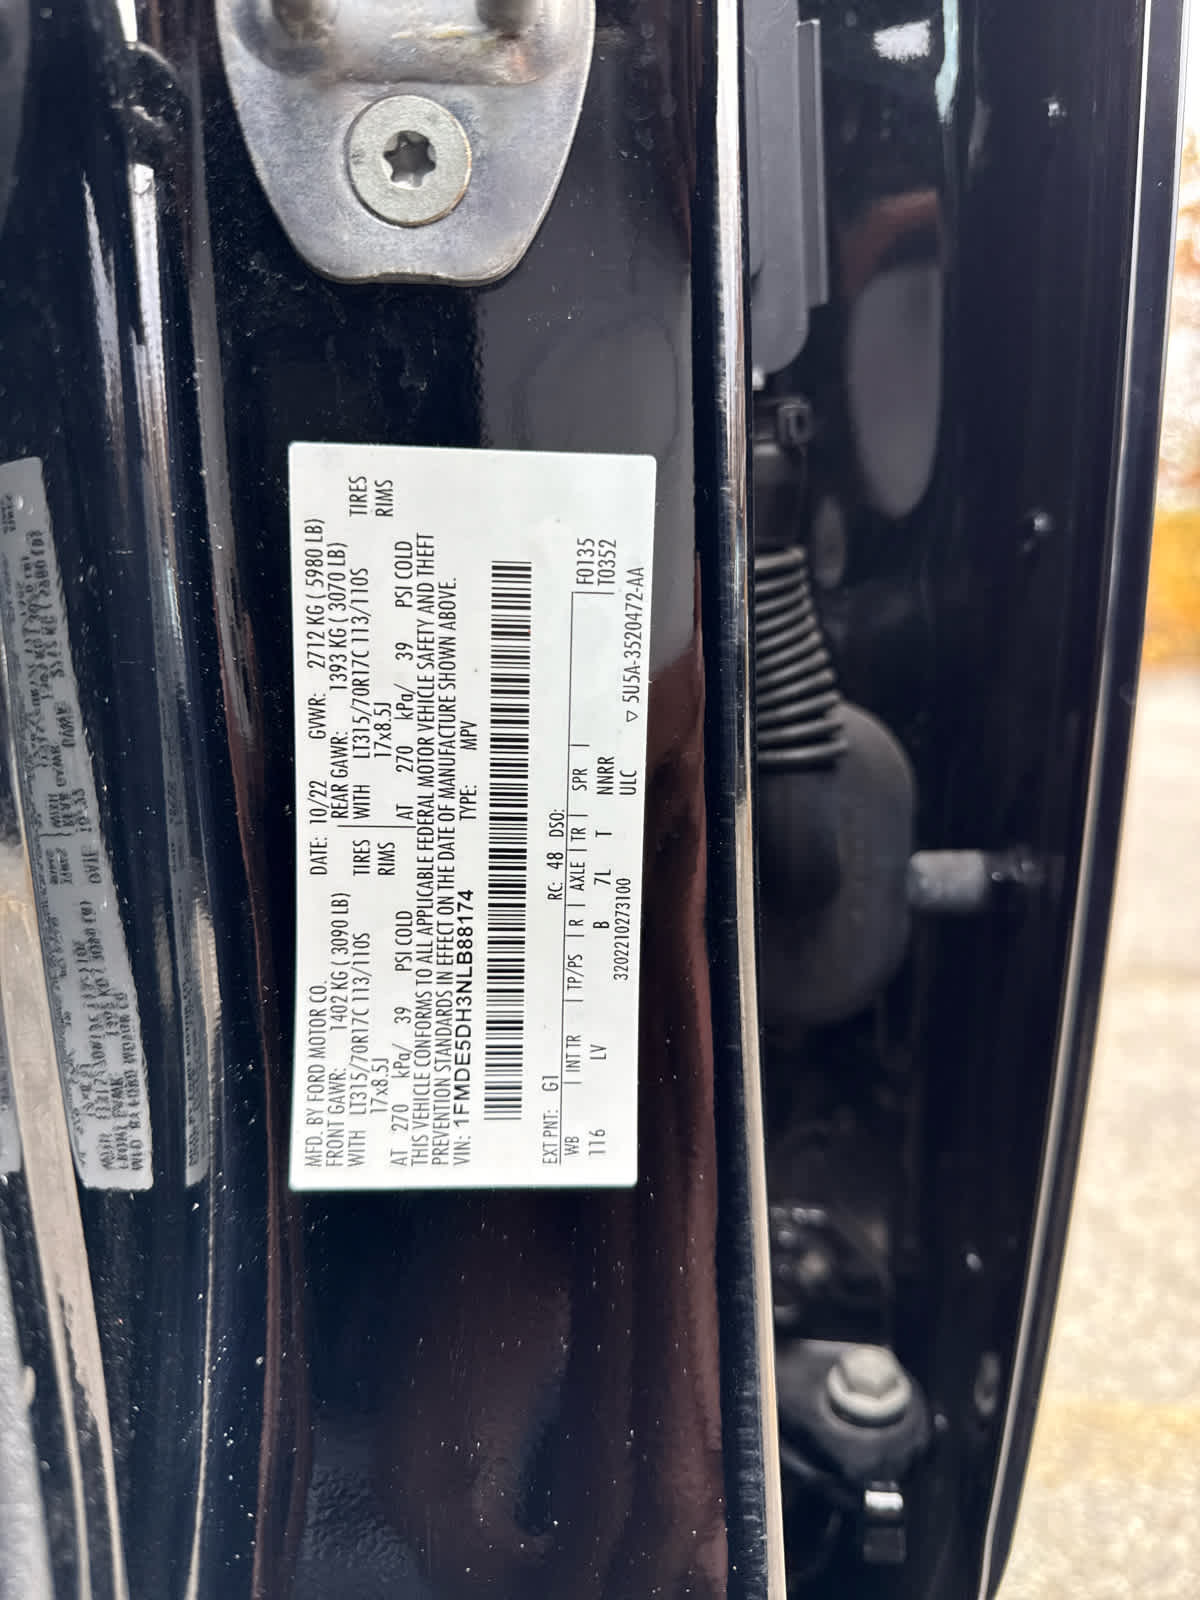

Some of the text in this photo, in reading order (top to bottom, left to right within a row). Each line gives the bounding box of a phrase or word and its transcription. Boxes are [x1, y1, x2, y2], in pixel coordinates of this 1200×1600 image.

[347, 475, 368, 518] TIRES
[374, 479, 394, 518] RIMS
[303, 518, 325, 543] LB)
[304, 548, 325, 589] 5980
[327, 542, 348, 567] LB)
[576, 537, 596, 585] F0135
[597, 539, 617, 587] T0352
[327, 571, 347, 612] 3070
[305, 604, 326, 626] KG
[306, 630, 326, 669] 2712
[327, 627, 348, 649] KG
[329, 653, 349, 691] 1393
[393, 540, 416, 821] AT 270 kPa/ 39 PSI COLD
[349, 567, 371, 820] WITH LT315/70R17C 113/110S
[307, 692, 328, 740] GVWR:
[374, 701, 393, 758] 17x8.5J
[329, 731, 349, 779] GAWR:
[459, 720, 478, 821] TYPE: MPV
[571, 768, 588, 792] SPR
[596, 756, 614, 796] NNRR
[619, 769, 638, 796] ULC
[330, 783, 349, 819] REAR
[307, 780, 329, 876] DATE: 10/22
[548, 808, 565, 838] DSO:
[570, 827, 587, 843] TR
[595, 829, 613, 838] T
[351, 839, 371, 877] TIRES
[377, 841, 396, 876] RIMS
[411, 532, 435, 1167] THIS VEHICLE CONFORMS TO ALL APPLICABLE FEDERAL MOTOR VEHICLE SAFETY AND THEFT
[431, 577, 457, 1165] PREVENTION STANDARDS IN EFFECT ON THE DATE OF MANUFACTURE SHOWN ABOVE.
[547, 851, 564, 901] RC: 48
[569, 861, 586, 892] AXLE
[594, 868, 611, 886] 7L
[330, 892, 351, 915] LB)
[568, 919, 584, 927] R
[330, 919, 350, 955] 3090
[593, 920, 610, 929] B
[614, 877, 632, 981] 3202210273100
[330, 970, 349, 990] KG
[567, 953, 584, 992] TP/PS
[329, 995, 349, 1031] 1402
[453, 889, 474, 1166] VIN: 1FMDE5DH3NLB88174
[347, 931, 371, 1167] WITH LT315/70R17C 113/110S
[391, 910, 414, 1167] AT 270 kPa/ 39 PSI COLD
[565, 1034, 582, 1073] INT TR
[590, 1043, 607, 1060] LV
[304, 980, 328, 1168] MFD. BY FORD MOTOR CO.
[327, 1067, 347, 1115] GAWR:
[370, 1057, 390, 1114] 17x8.5J
[326, 1119, 345, 1167] FRONT
[542, 1109, 559, 1138] PNT:
[588, 1128, 606, 1156] 116
[542, 1141, 558, 1164] EXT
[564, 1136, 580, 1156] WB
